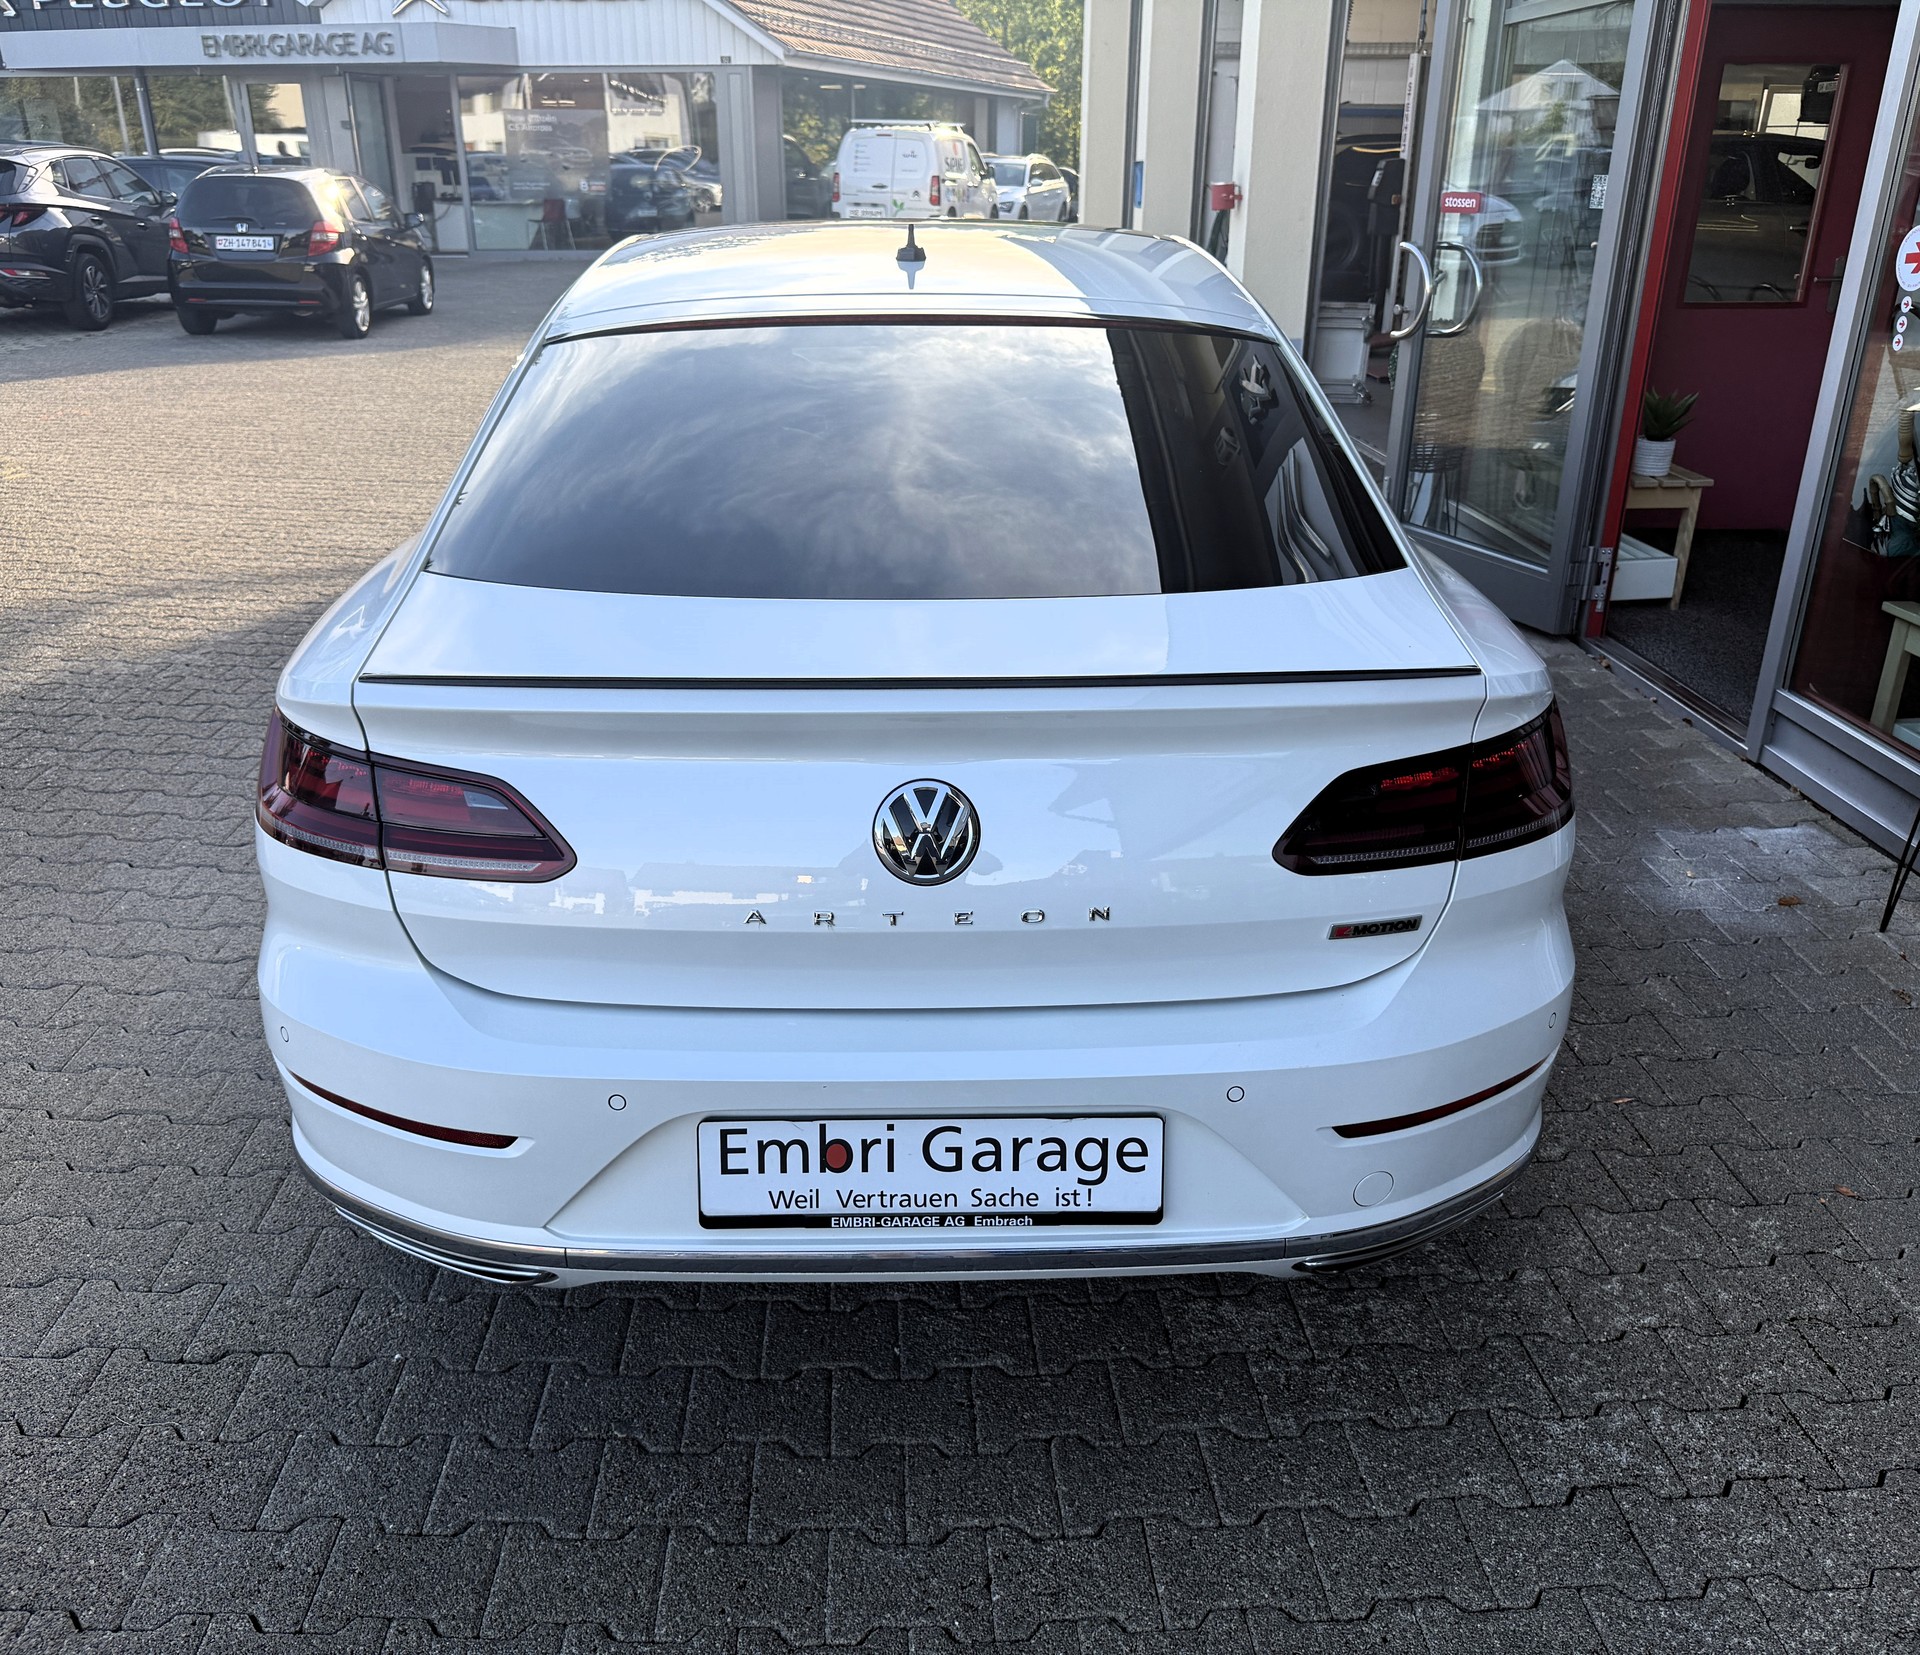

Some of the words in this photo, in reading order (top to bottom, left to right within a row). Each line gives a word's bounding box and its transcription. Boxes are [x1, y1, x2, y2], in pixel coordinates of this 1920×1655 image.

[201, 33, 359, 58] EMBRI-GARAGE
[361, 32, 395, 56] AG
[1444, 197, 1476, 208] stossen
[744, 906, 1111, 927] ARTEON
[719, 1123, 895, 1175] Embri
[921, 1125, 1149, 1186] Garage
[768, 1188, 820, 1209] Weil
[836, 1189, 958, 1208] Vertrauen
[970, 1187, 1039, 1208] Sache
[831, 1215, 941, 1228] EMBRI-GARAGE
[944, 1215, 966, 1227] AG
[974, 1214, 1034, 1227] Embrach
